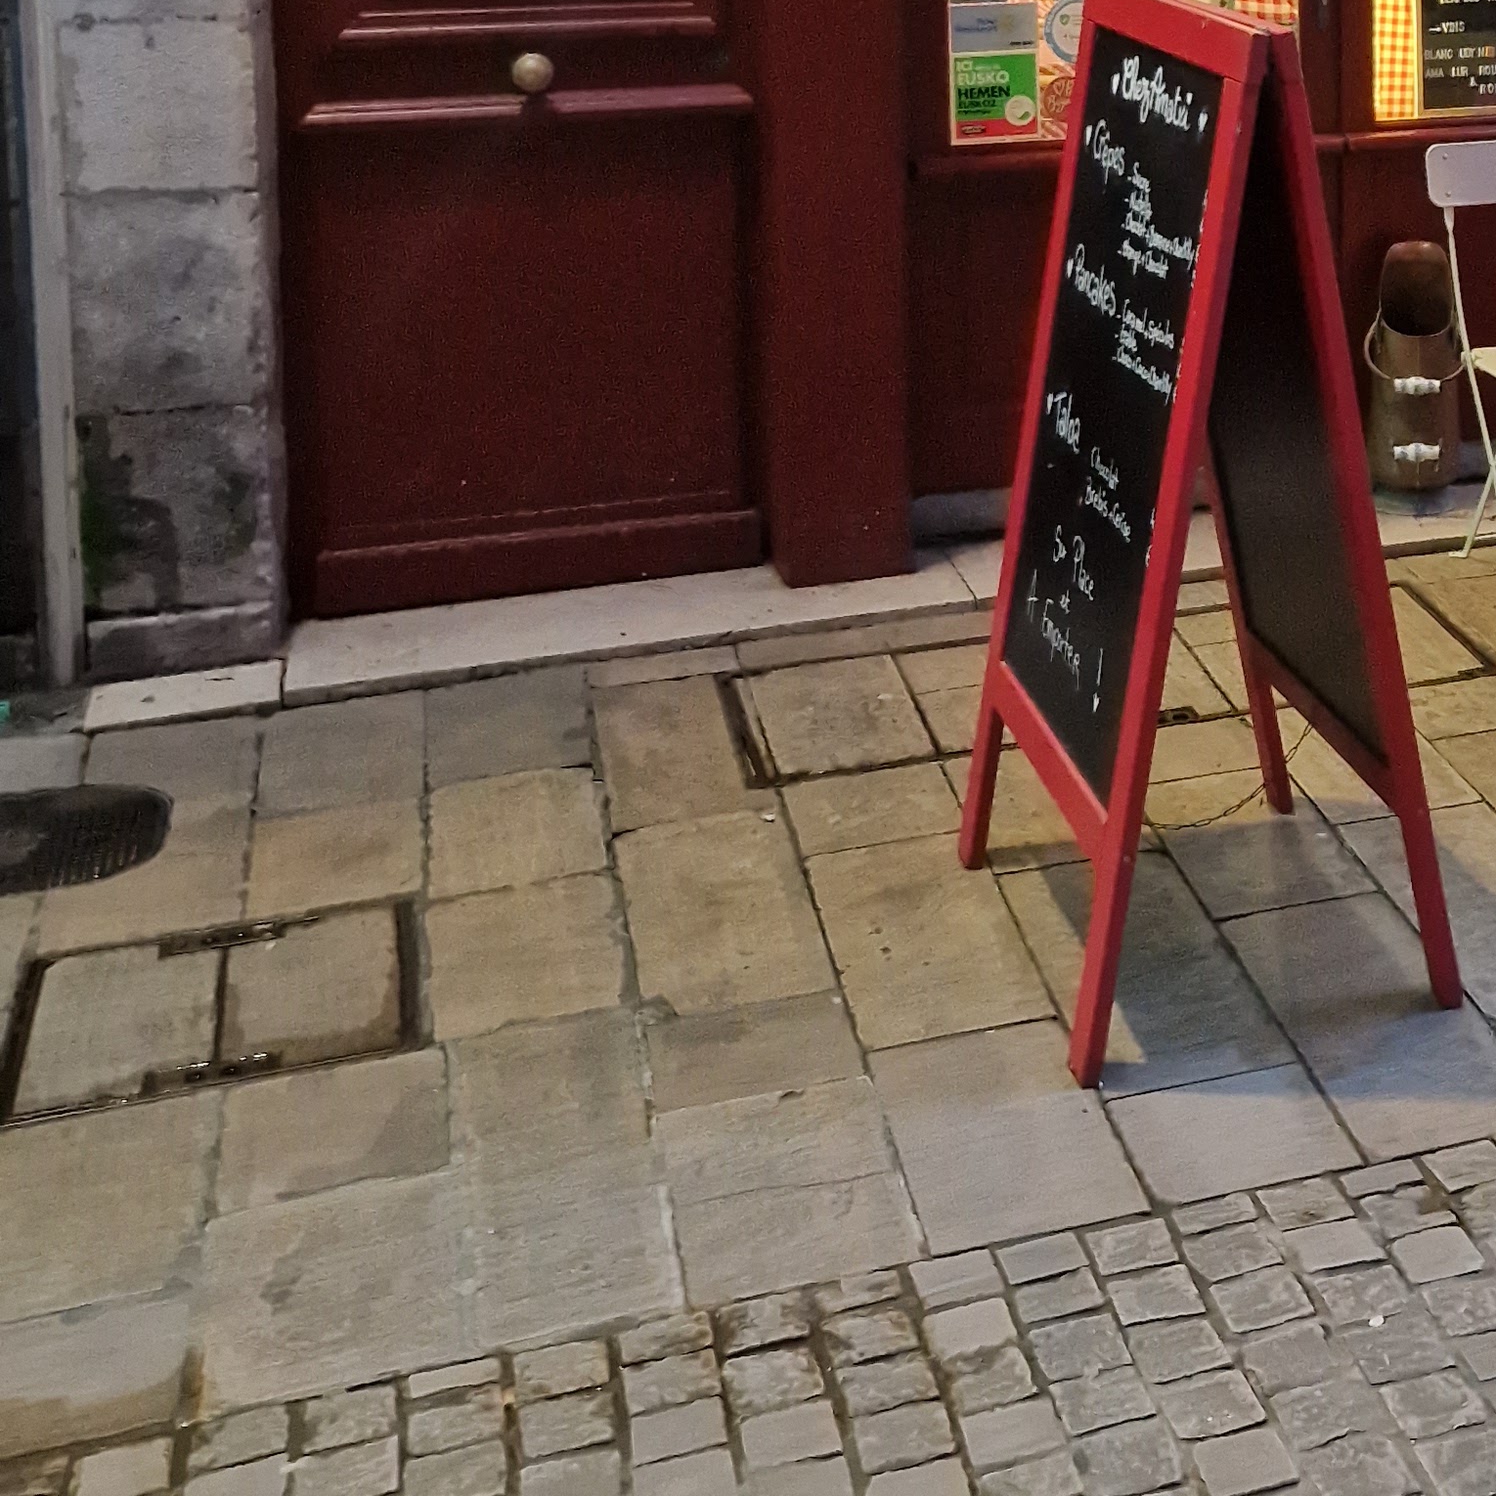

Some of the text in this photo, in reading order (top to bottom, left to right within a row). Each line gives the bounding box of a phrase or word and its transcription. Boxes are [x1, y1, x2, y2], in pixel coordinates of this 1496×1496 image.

[1425, 48, 1453, 60] BLANC
[957, 70, 1010, 85] EUSKO
[957, 86, 1011, 100] HEMEN
[1122, 55, 1151, 123] Chez
[1075, 244, 1116, 316] Pancakes
[1073, 535, 1095, 601] Place
